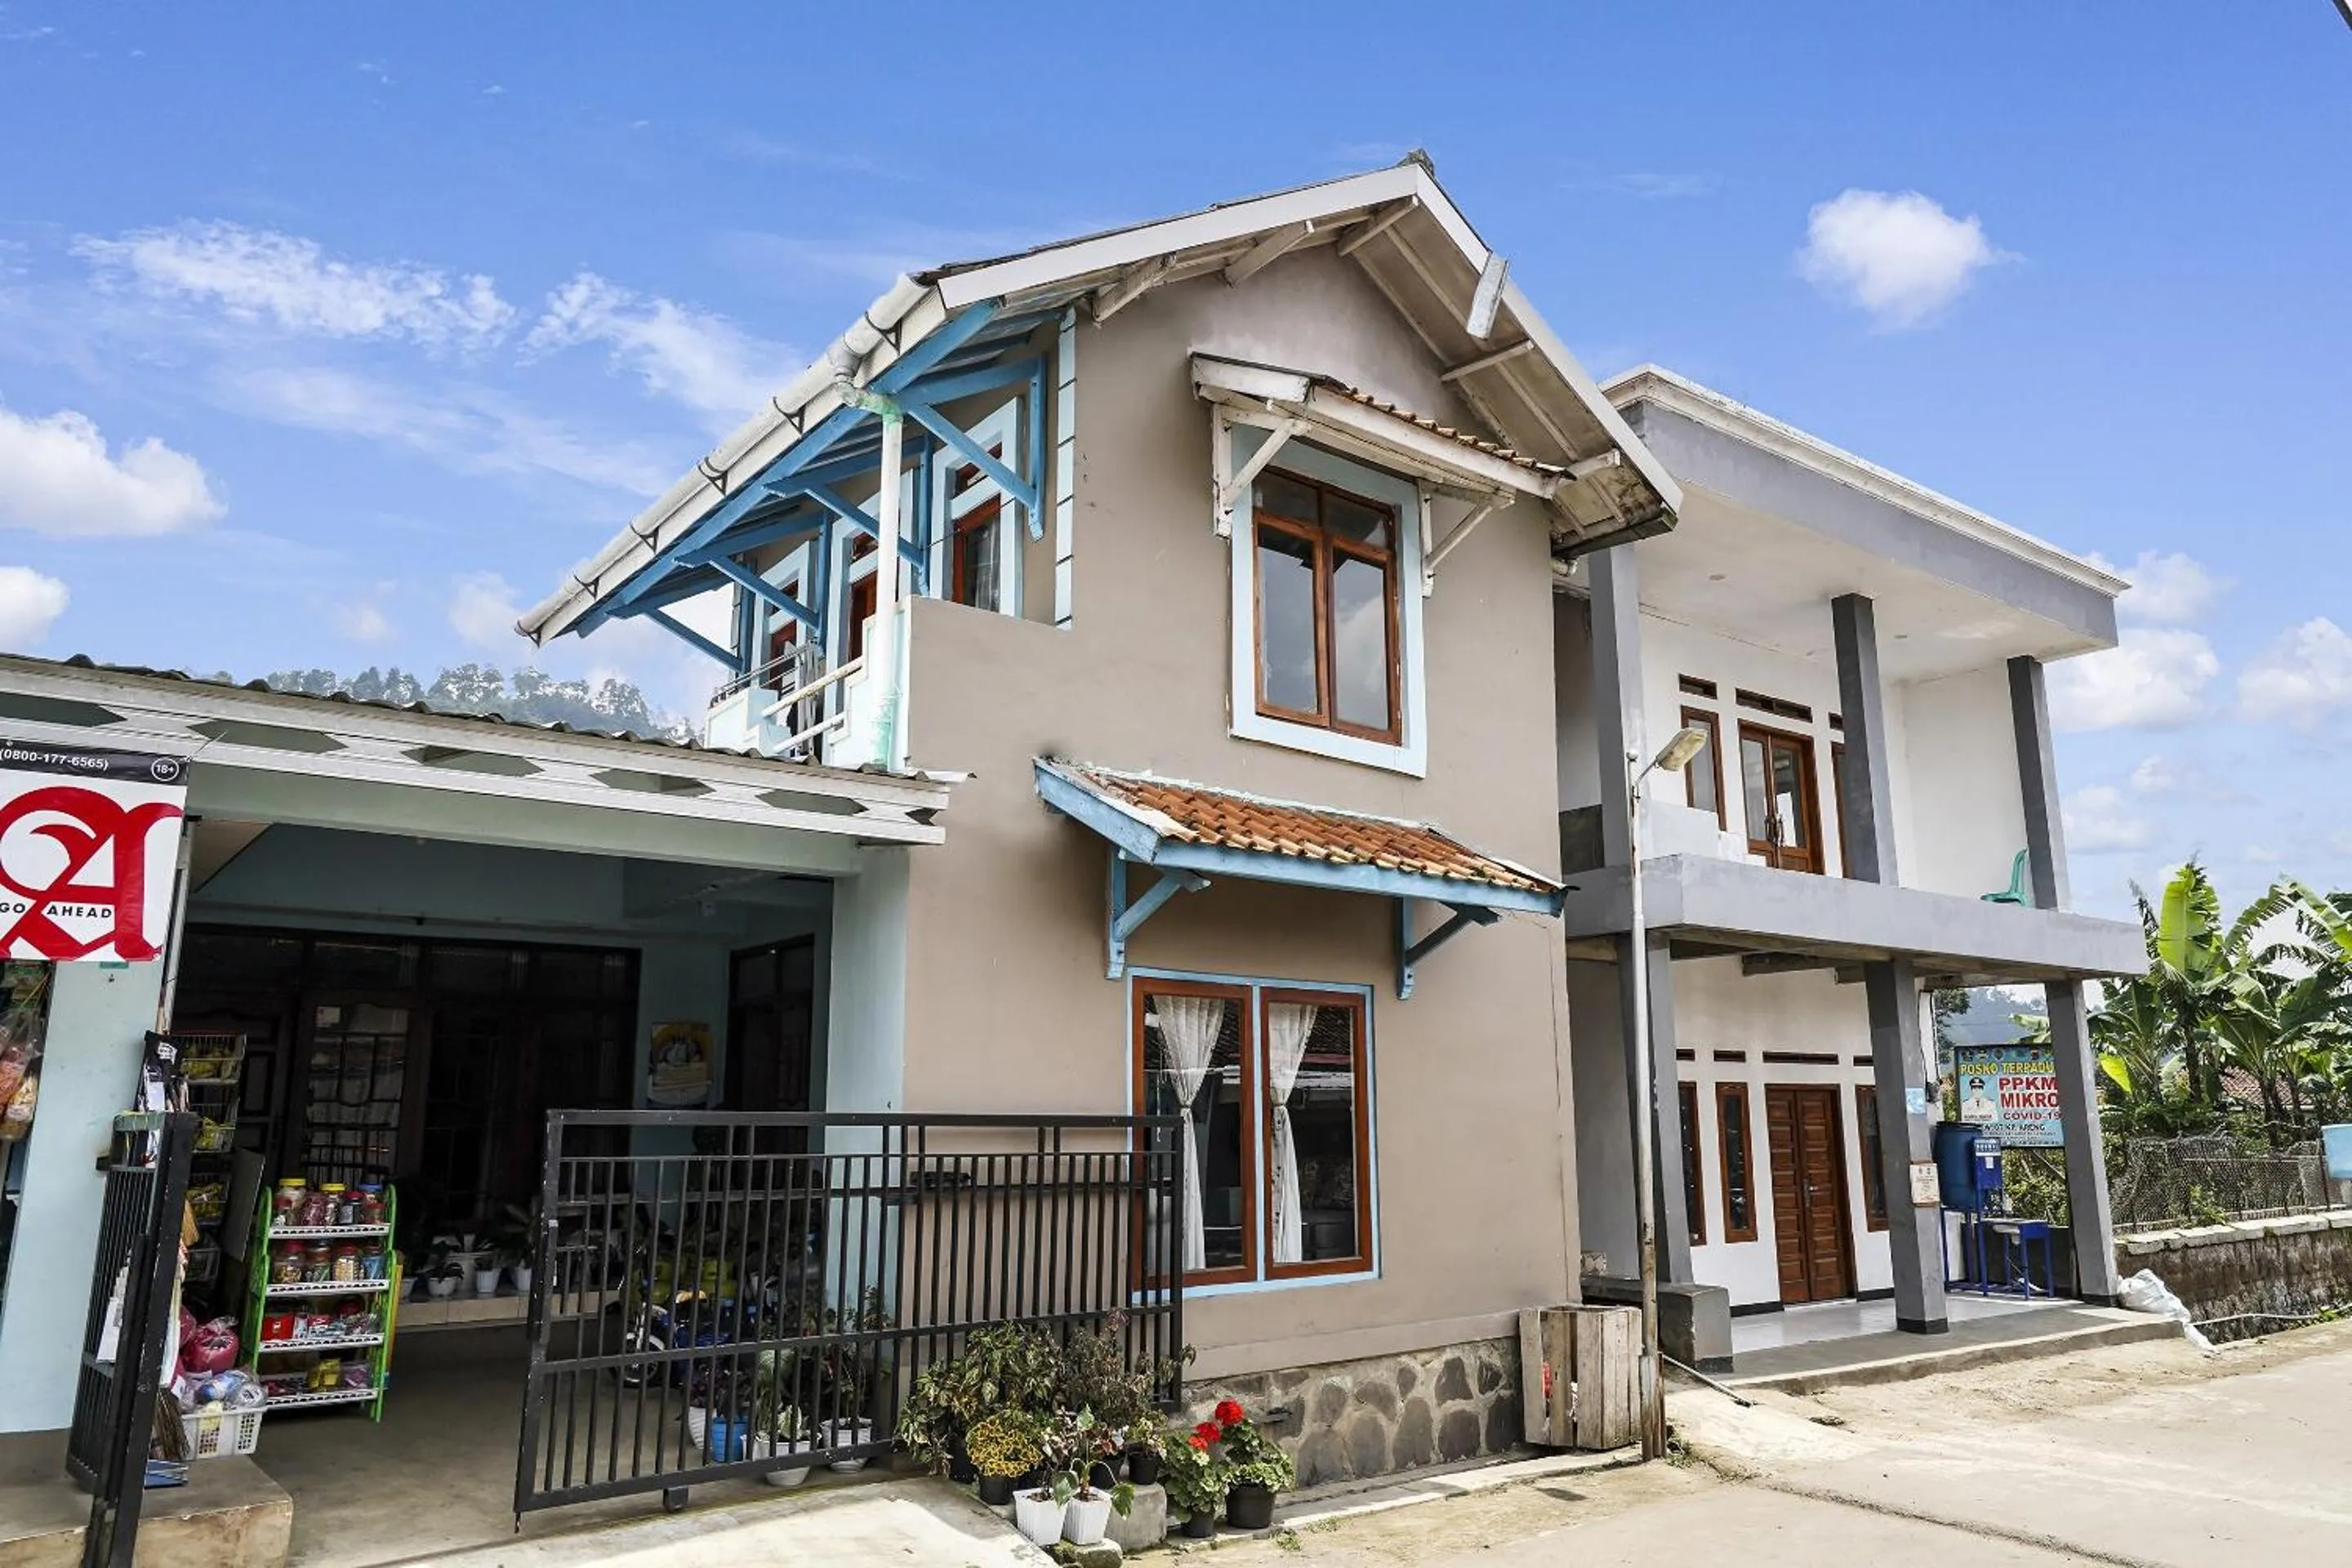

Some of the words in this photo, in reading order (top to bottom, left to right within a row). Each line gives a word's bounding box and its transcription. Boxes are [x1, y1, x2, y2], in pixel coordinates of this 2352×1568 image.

[0, 749, 109, 771] (0800-177-6565)
[155, 763, 175, 774] 18+
[0, 902, 26, 914] GO
[47, 905, 112, 918] AHEAD
[1960, 1062, 1998, 1075] POSKO
[2002, 1061, 2055, 1074] TERPADU
[1998, 1076, 2058, 1091] PPKM
[2000, 1092, 2060, 1108] MIKRO
[2003, 1111, 2062, 1120] COVID-19
